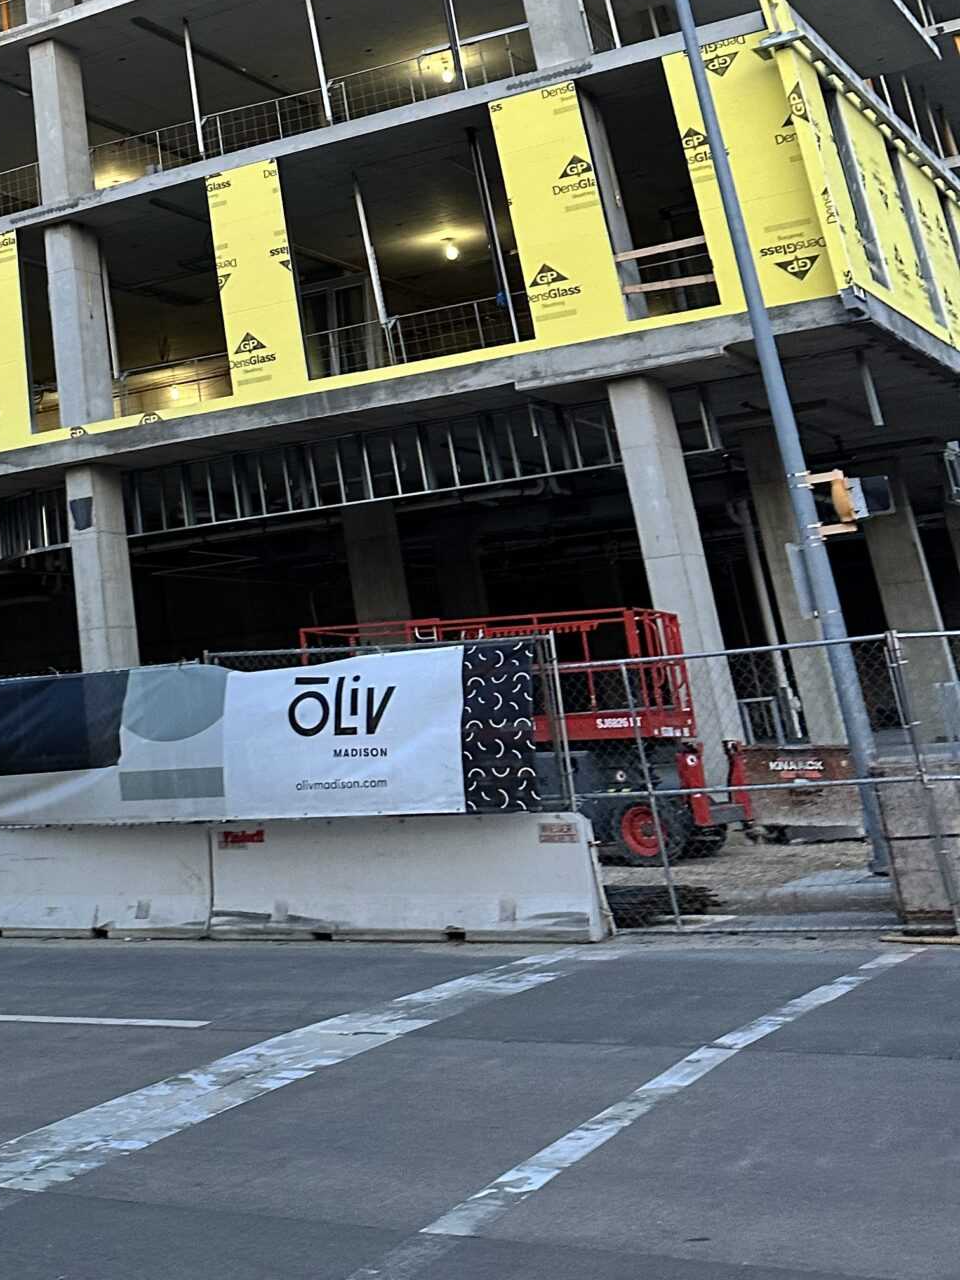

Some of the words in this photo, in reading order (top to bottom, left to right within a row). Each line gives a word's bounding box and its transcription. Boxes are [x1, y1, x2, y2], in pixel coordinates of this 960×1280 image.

[541, 82, 576, 99] DensG
[683, 135, 704, 148] GP
[566, 162, 588, 175] GP
[206, 180, 232, 192] Glass
[552, 178, 597, 196] DensGla
[787, 259, 811, 273] GP
[536, 271, 557, 284] GP
[528, 286, 581, 303] ensGlass
[240, 339, 258, 351] GP
[333, 748, 388, 758] MADISON
[296, 779, 388, 791] olivmadison.com
